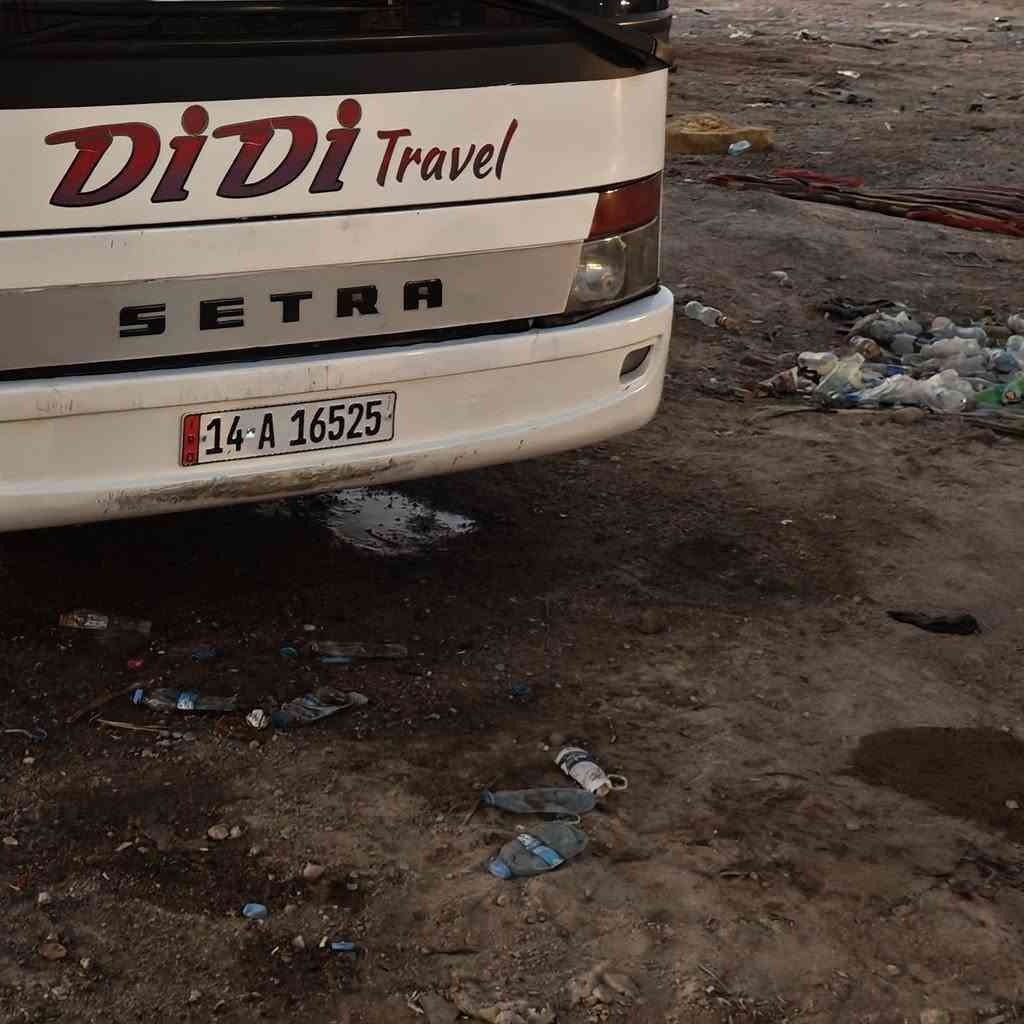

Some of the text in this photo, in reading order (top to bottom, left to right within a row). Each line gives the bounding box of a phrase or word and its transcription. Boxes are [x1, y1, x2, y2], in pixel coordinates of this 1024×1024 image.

[376, 118, 519, 187] Travel
[119, 278, 444, 338] SETRA
[205, 400, 382, 455] 14 A 16525
